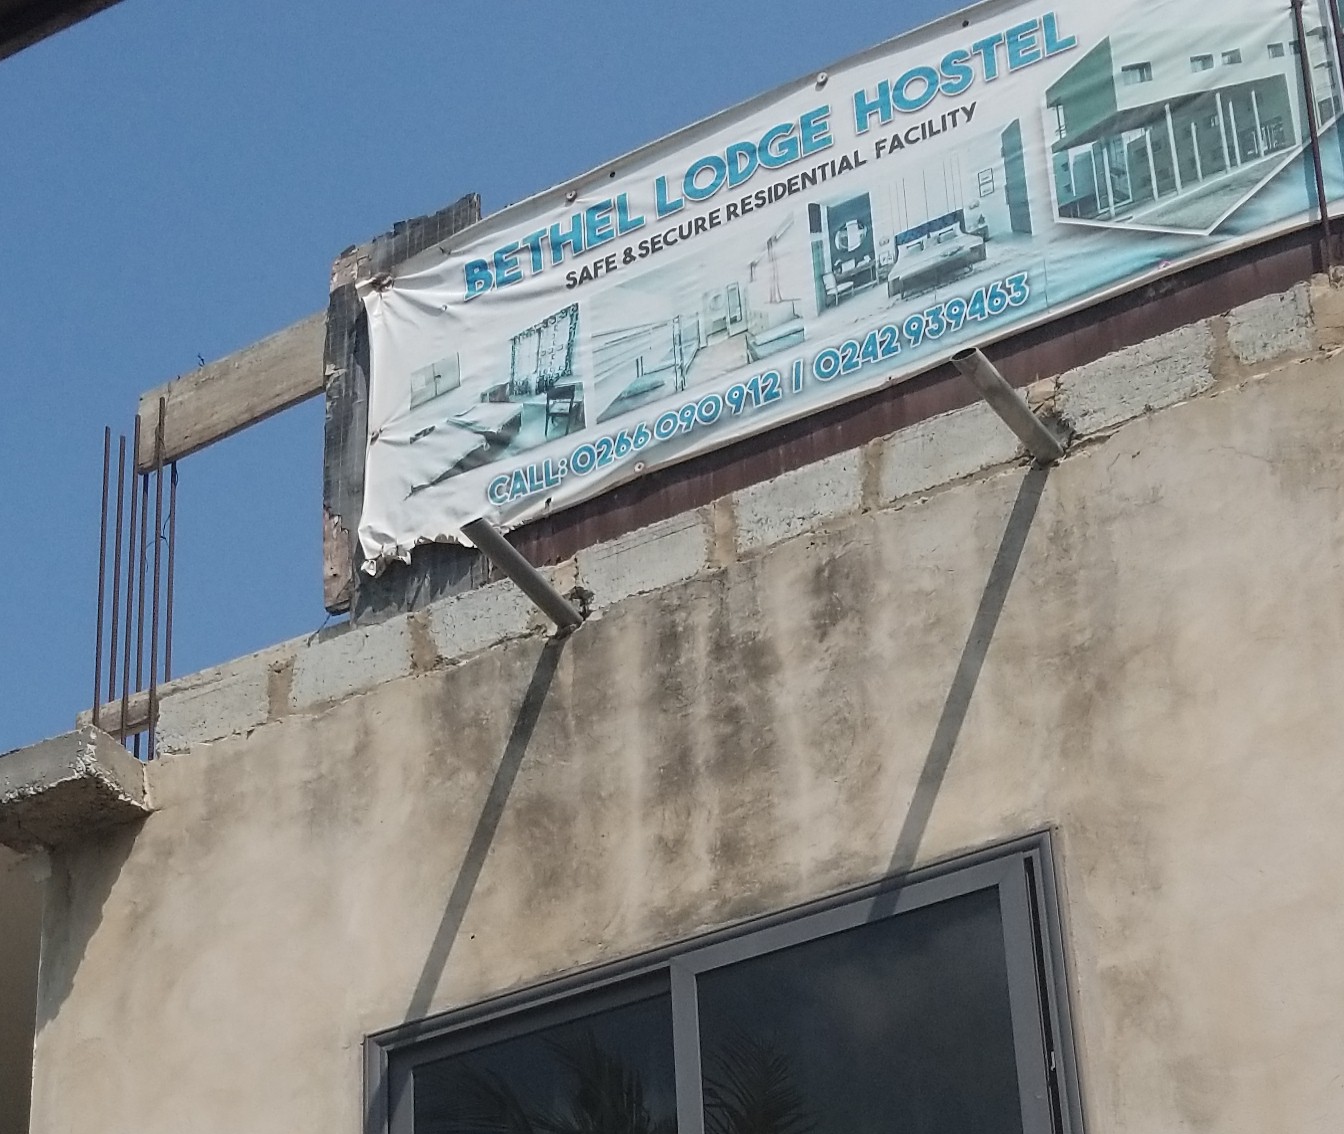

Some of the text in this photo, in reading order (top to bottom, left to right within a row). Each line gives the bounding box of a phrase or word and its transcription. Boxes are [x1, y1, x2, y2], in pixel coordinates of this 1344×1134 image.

[464, 11, 1077, 302] BETHEL LODGE HOSTEL
[566, 101, 977, 290] SAFE & SECURE RESIDENTIAL FACILITY
[487, 457, 568, 506] CALL:
